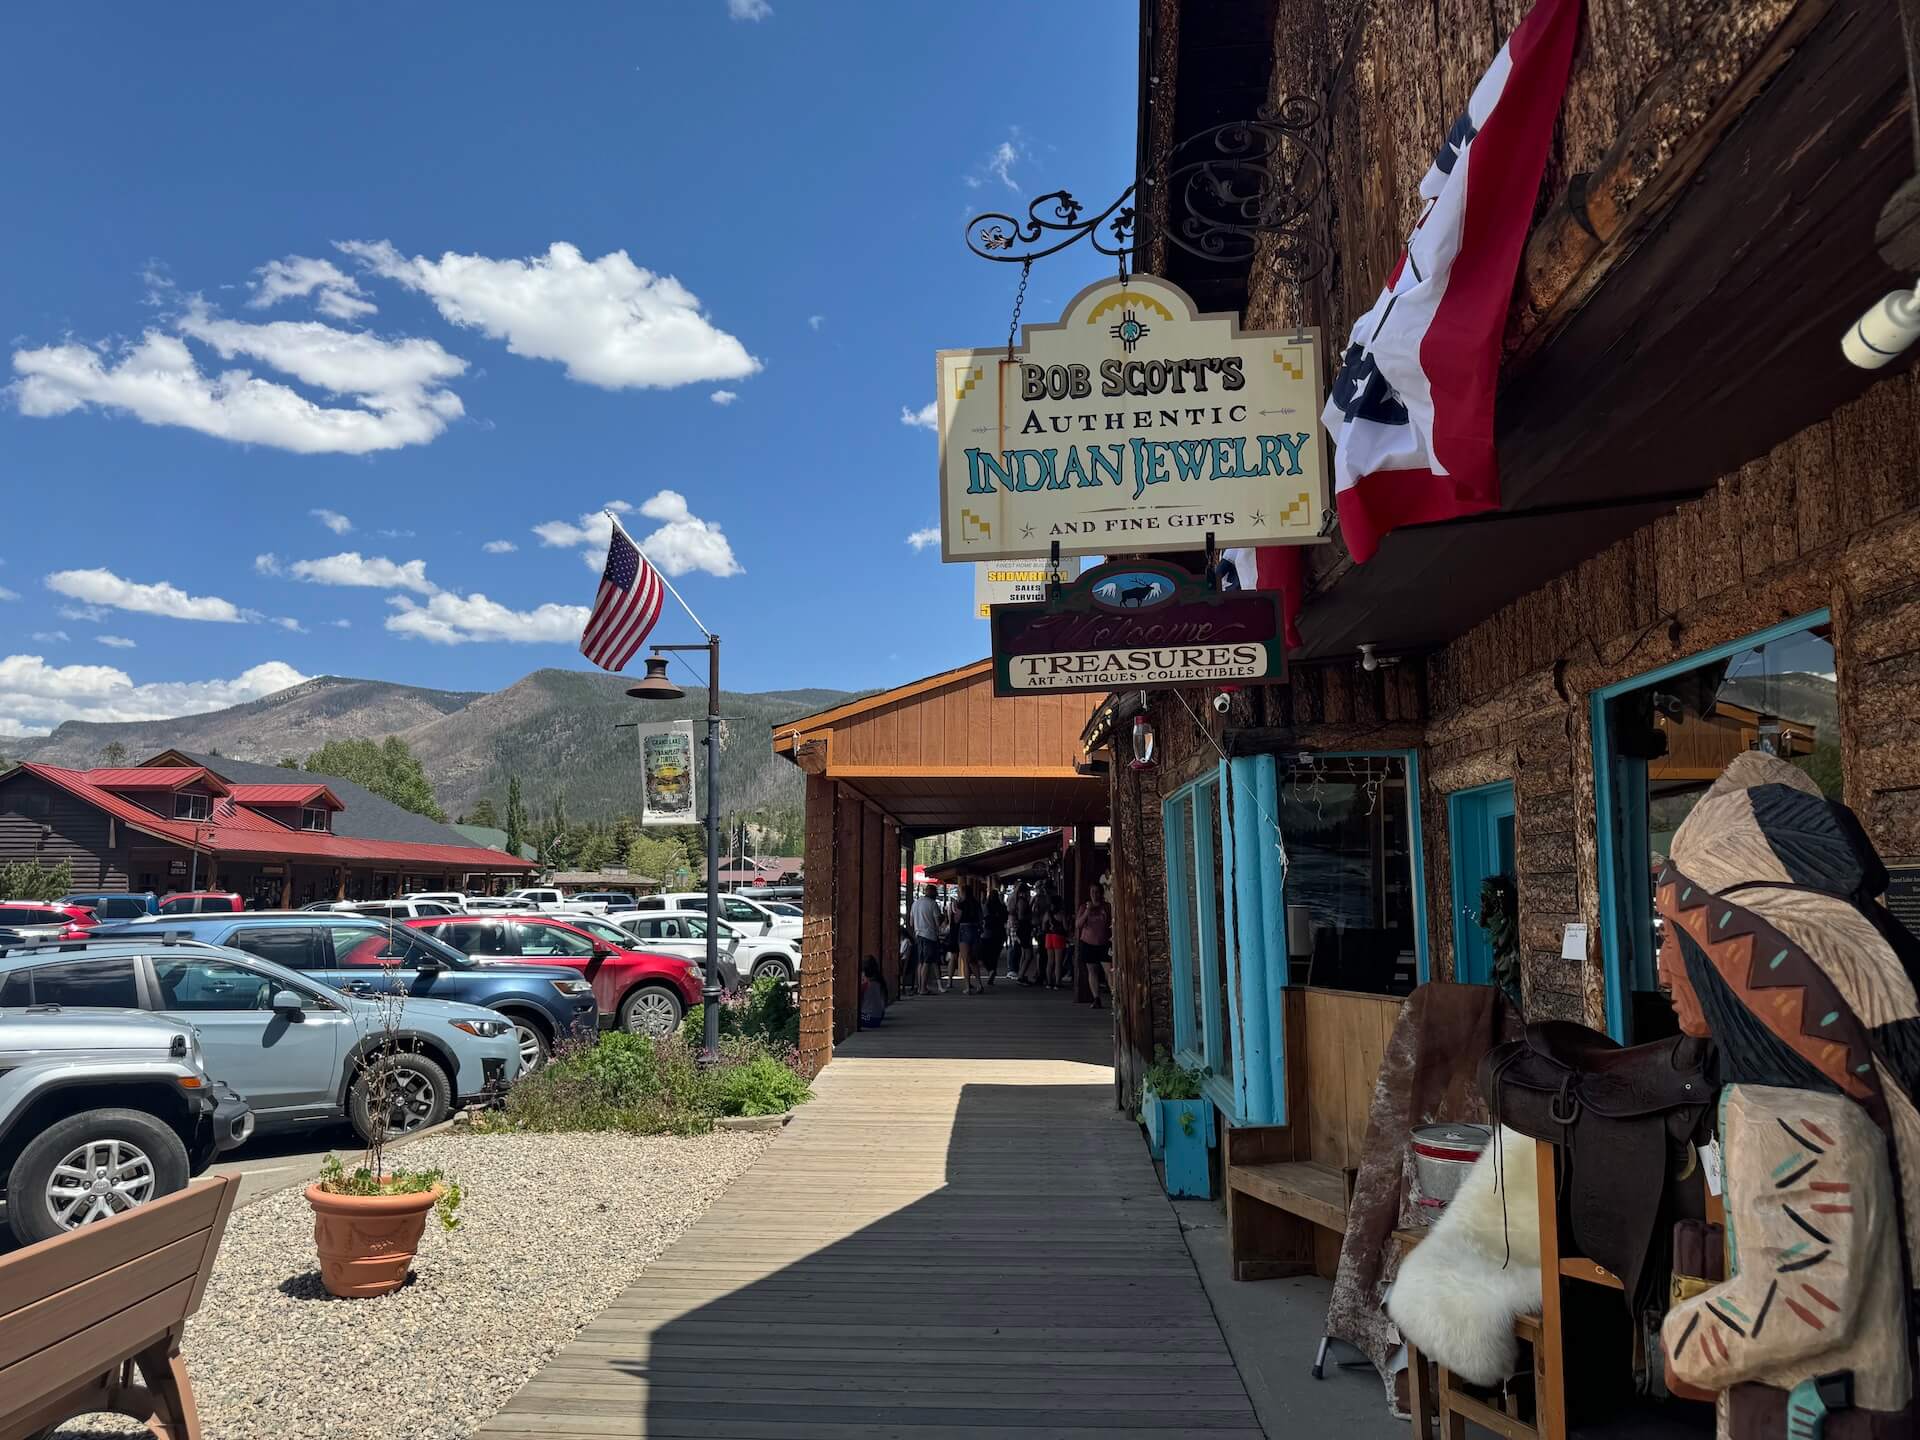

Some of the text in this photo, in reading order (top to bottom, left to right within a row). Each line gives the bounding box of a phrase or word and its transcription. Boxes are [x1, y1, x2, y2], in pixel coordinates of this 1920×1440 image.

[1019, 355, 1246, 402] BOB SCOTT'S
[1020, 405, 1248, 435] AUTHENTIC
[964, 432, 1311, 500] INDIAN JEWELRY
[1048, 511, 1236, 536] AND FINE GIFTS
[1015, 584, 1041, 592] SALES
[1020, 645, 1258, 676] TREASURES
[1028, 666, 1256, 687] ART ANTIQUES COLLECTIBLES
